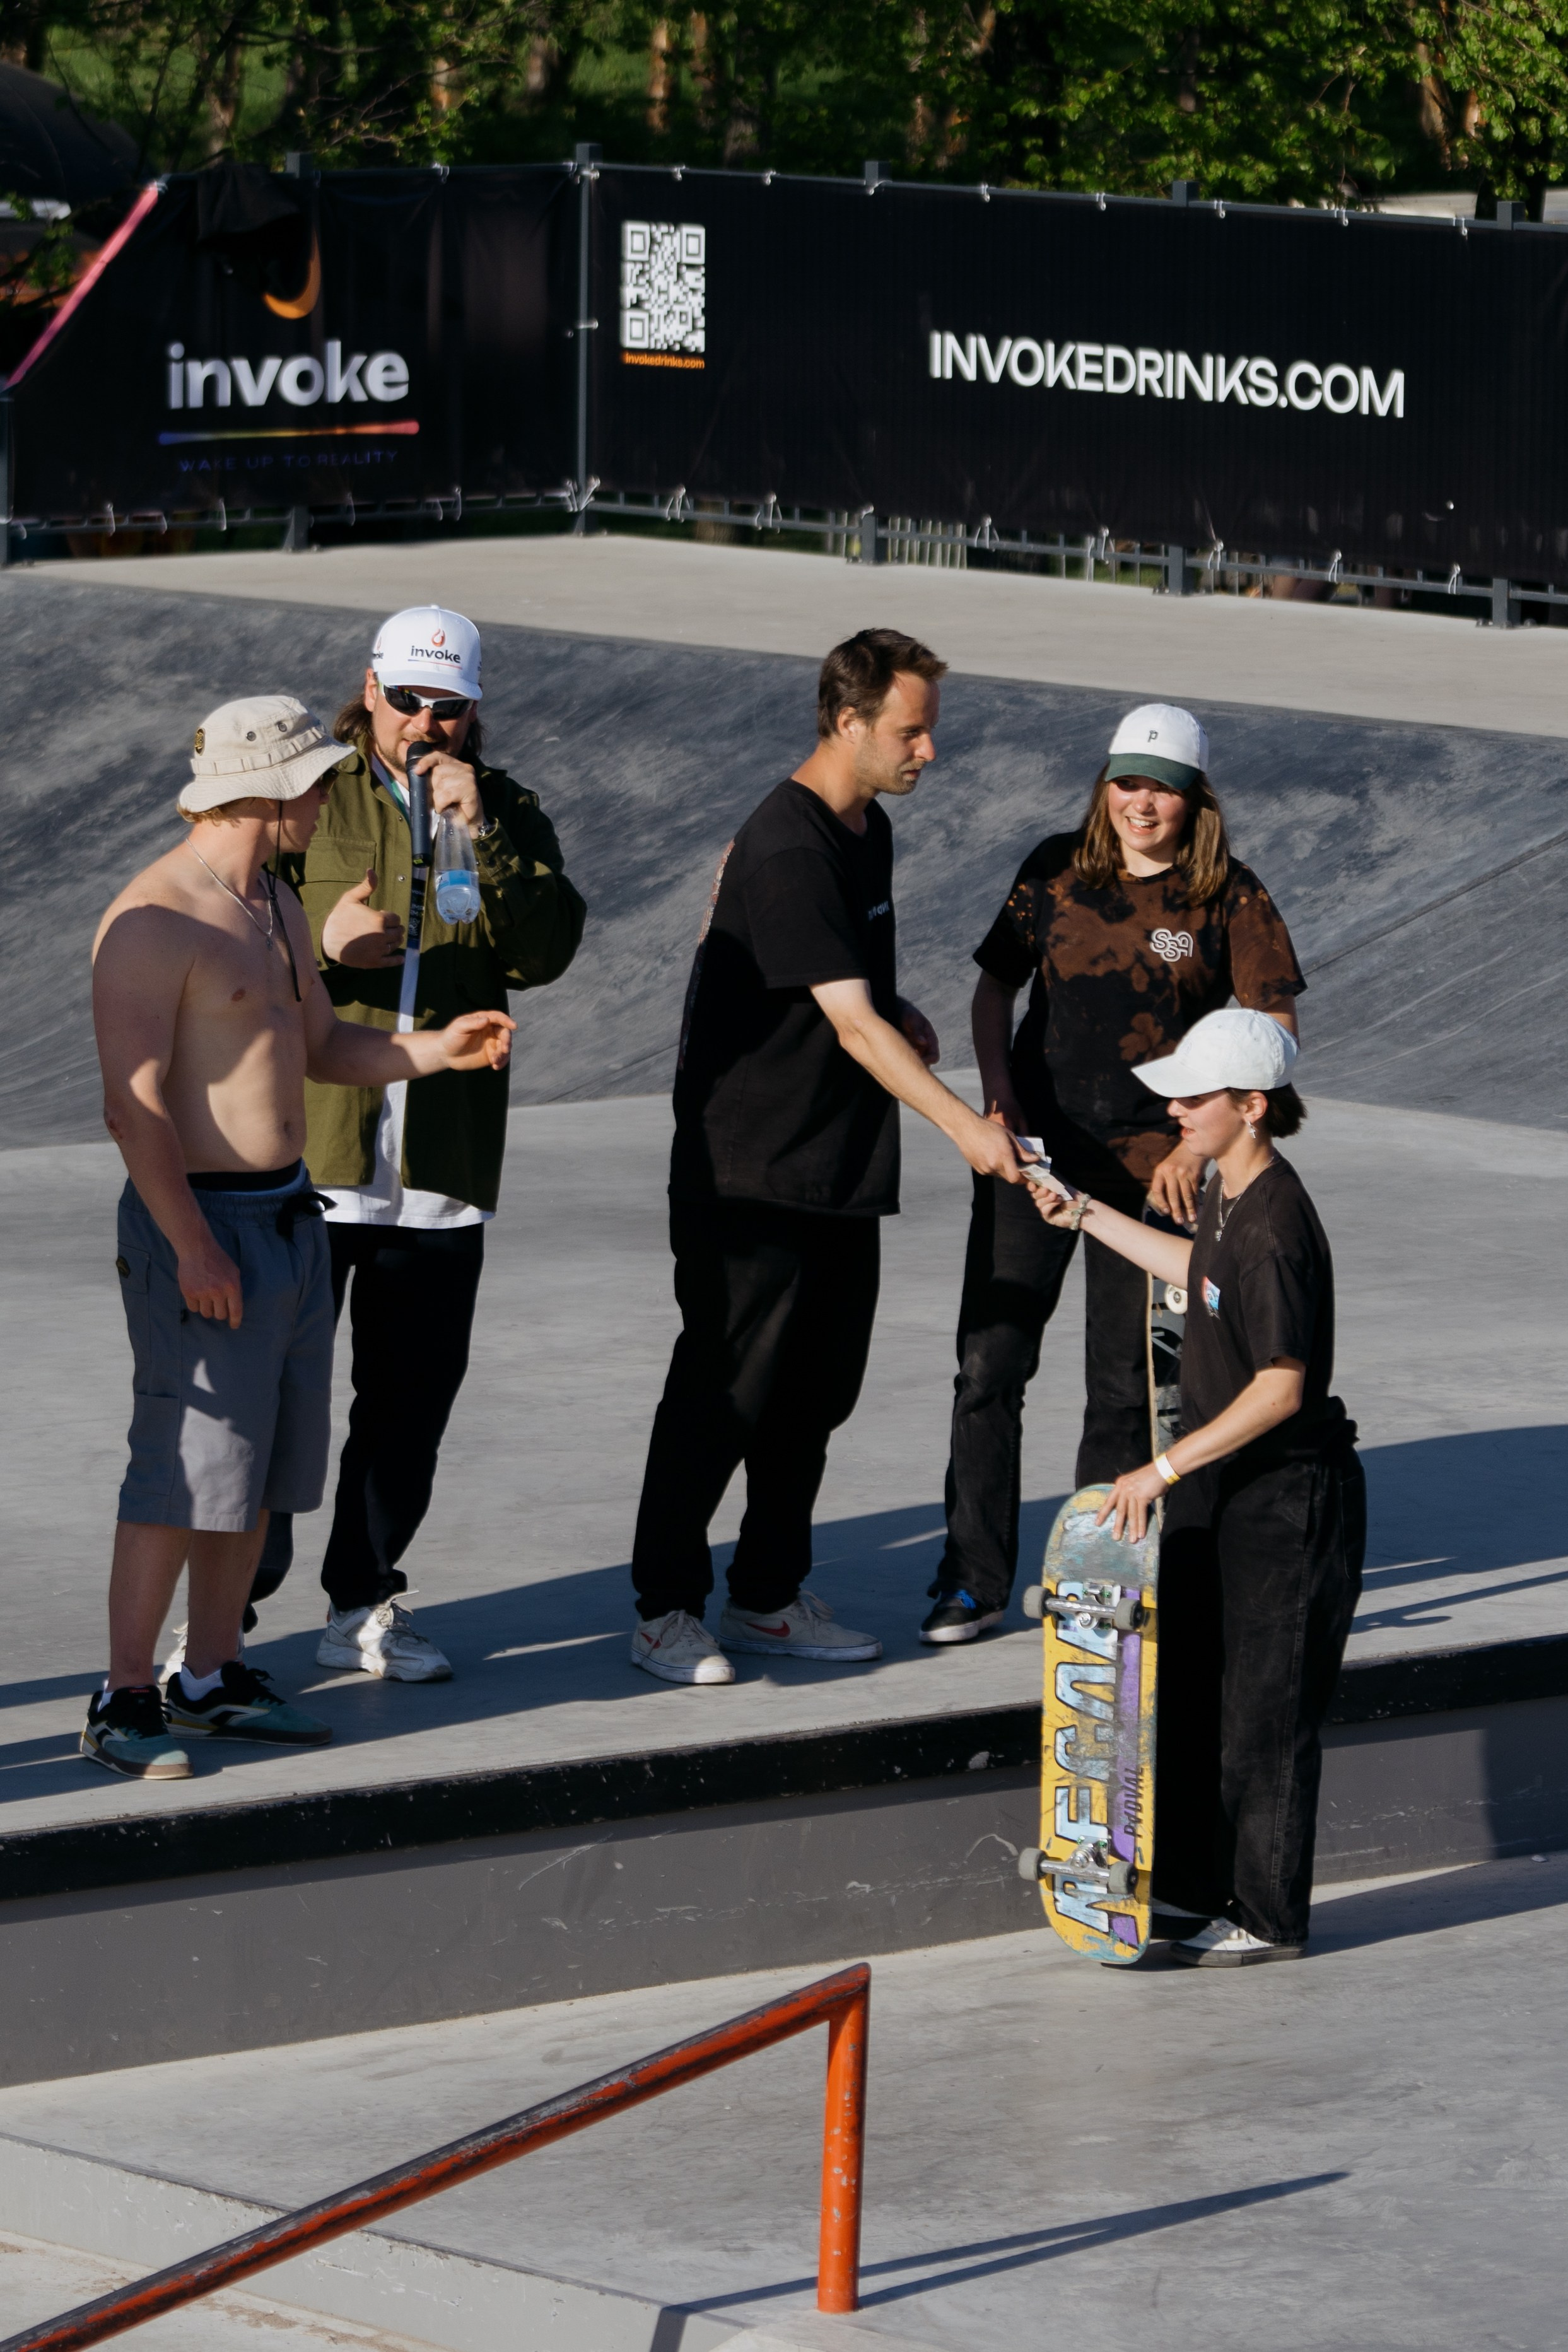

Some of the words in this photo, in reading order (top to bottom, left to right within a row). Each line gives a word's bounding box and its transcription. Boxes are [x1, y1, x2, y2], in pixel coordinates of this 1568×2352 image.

[624, 352, 705, 370] invokedrinks.com
[168, 338, 410, 410] invoke
[930, 329, 1405, 419] INVOKEDRINKS.COM
[178, 457, 237, 473] WAKE
[245, 455, 274, 470] UP
[283, 453, 312, 469] TO
[317, 449, 399, 467] REALITY
[410, 645, 462, 664] invoke
